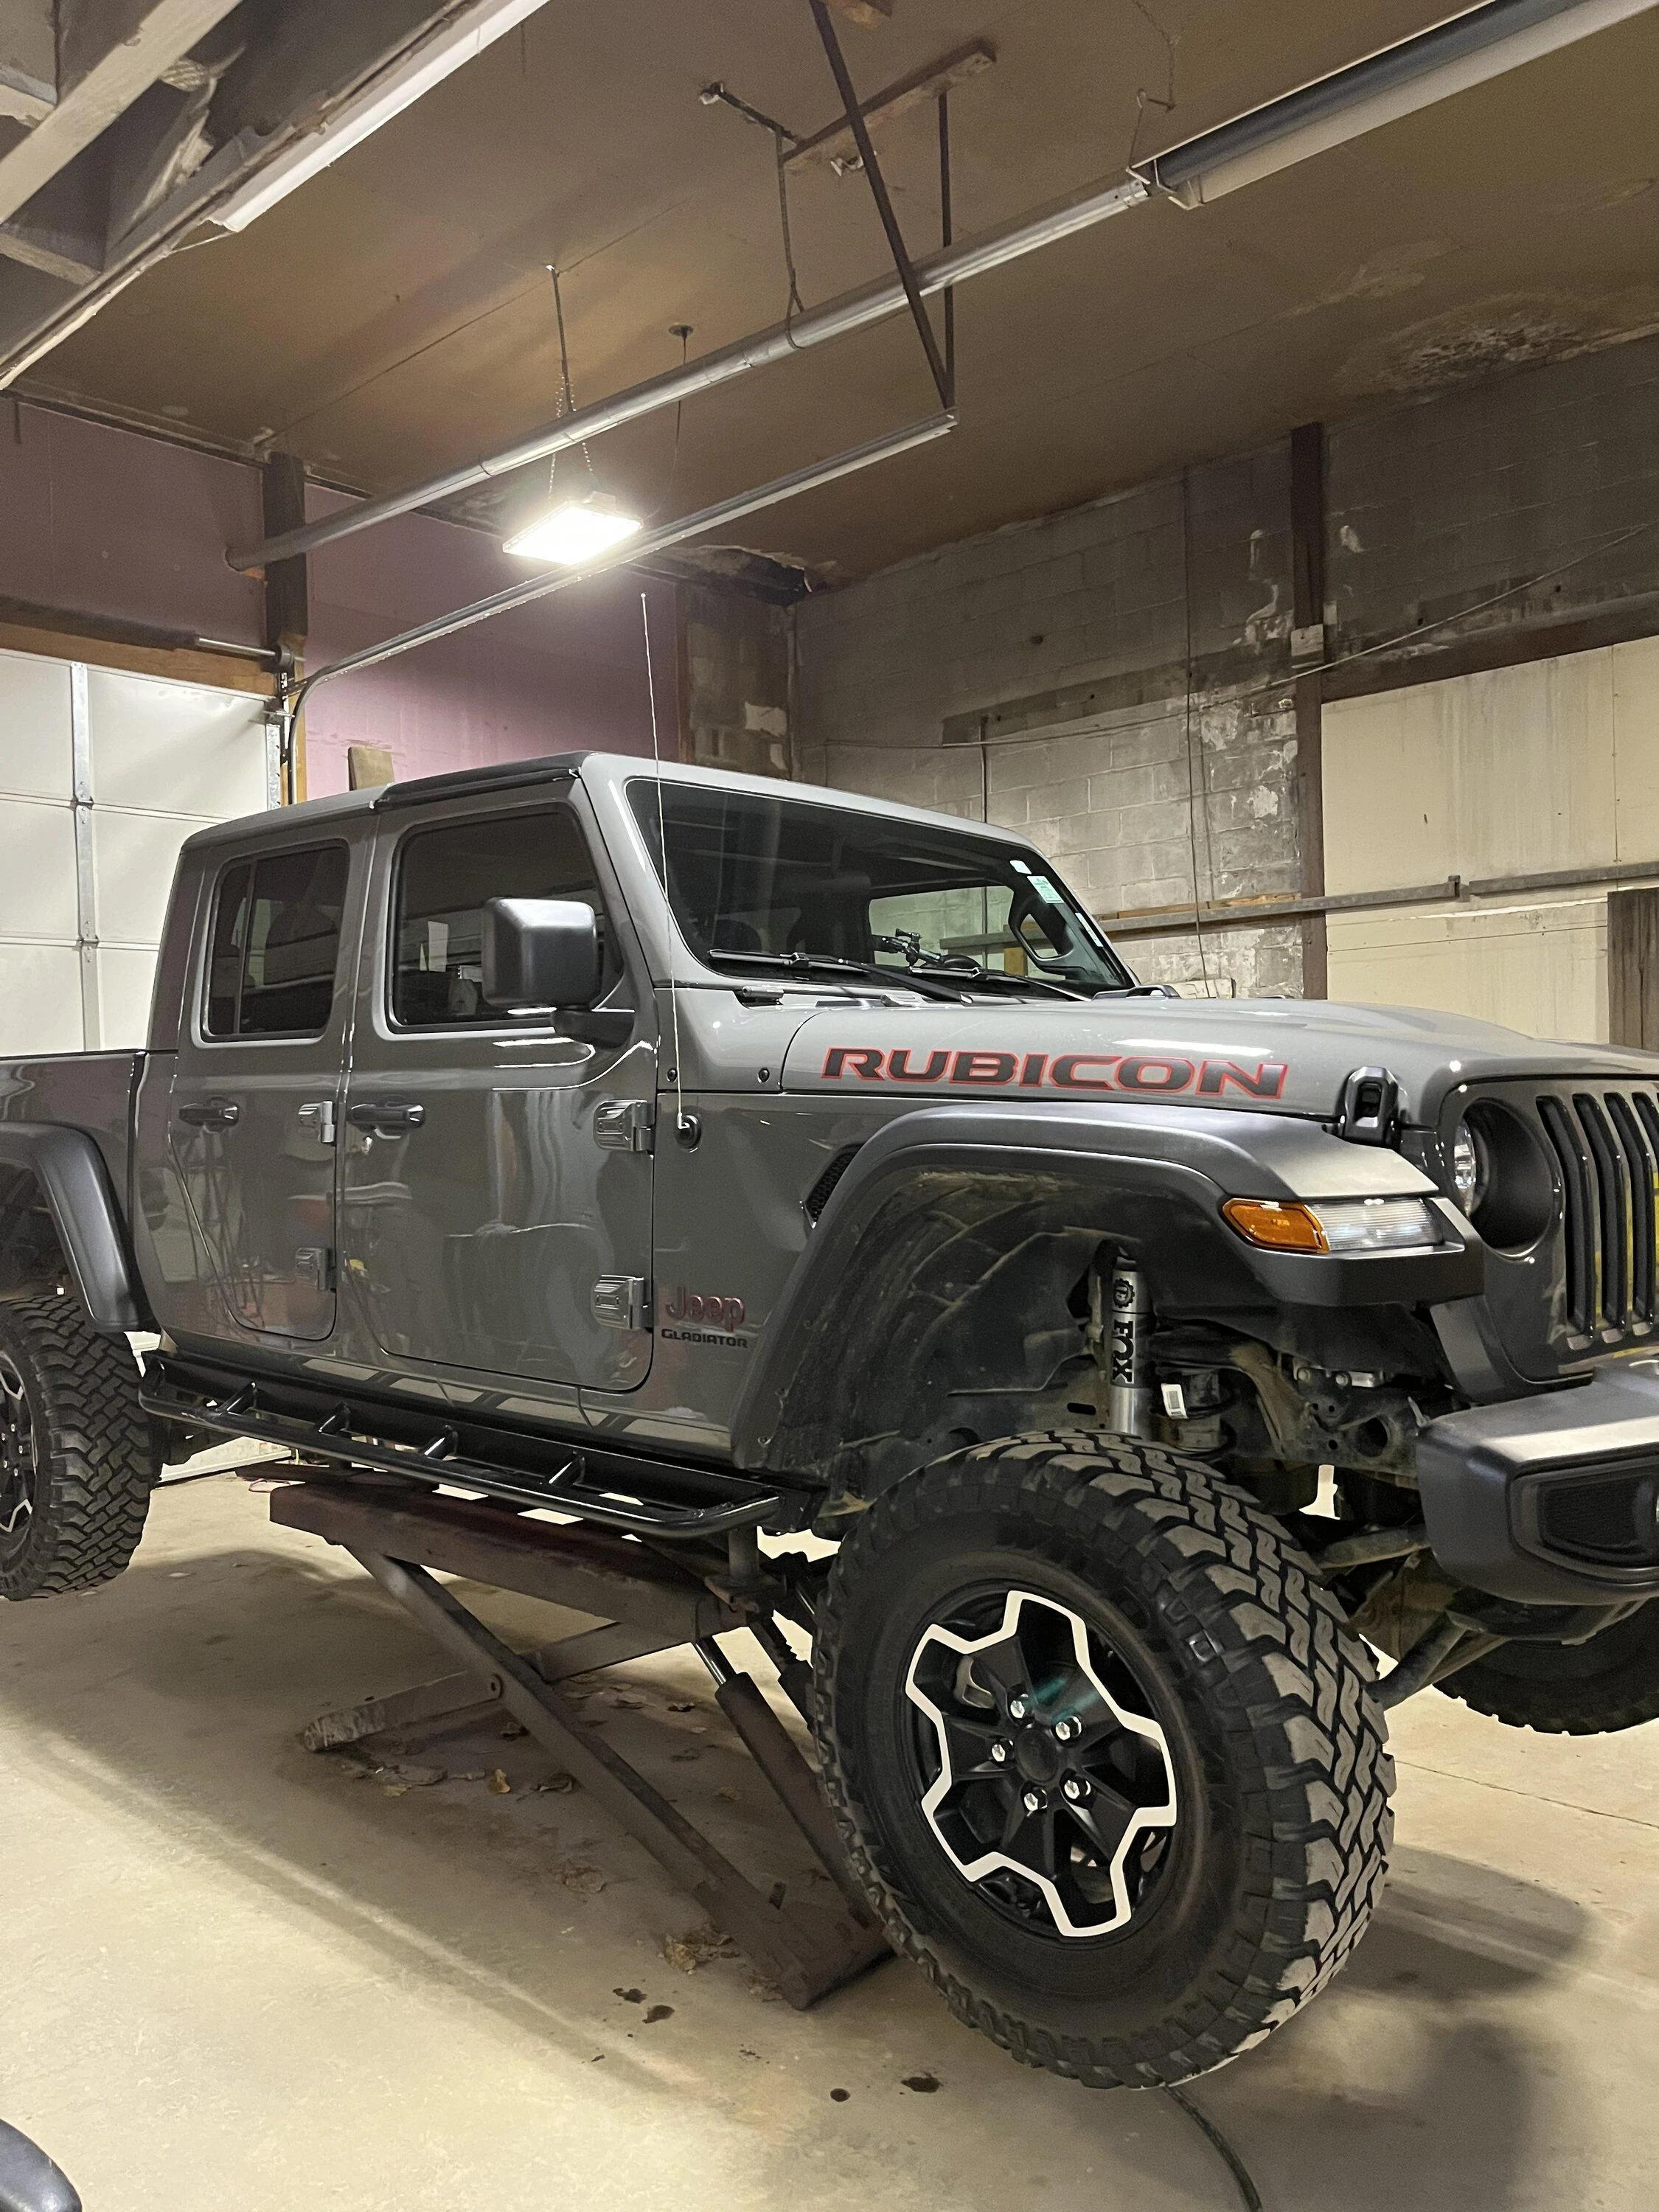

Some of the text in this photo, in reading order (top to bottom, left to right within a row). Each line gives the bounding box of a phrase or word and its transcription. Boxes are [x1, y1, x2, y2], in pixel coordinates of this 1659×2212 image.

[821, 1047, 1289, 1099] RUBICON
[665, 1286, 745, 1332] Jeep
[661, 1328, 748, 1348] GLADIATOR
[1113, 1318, 1135, 1384] FOX
